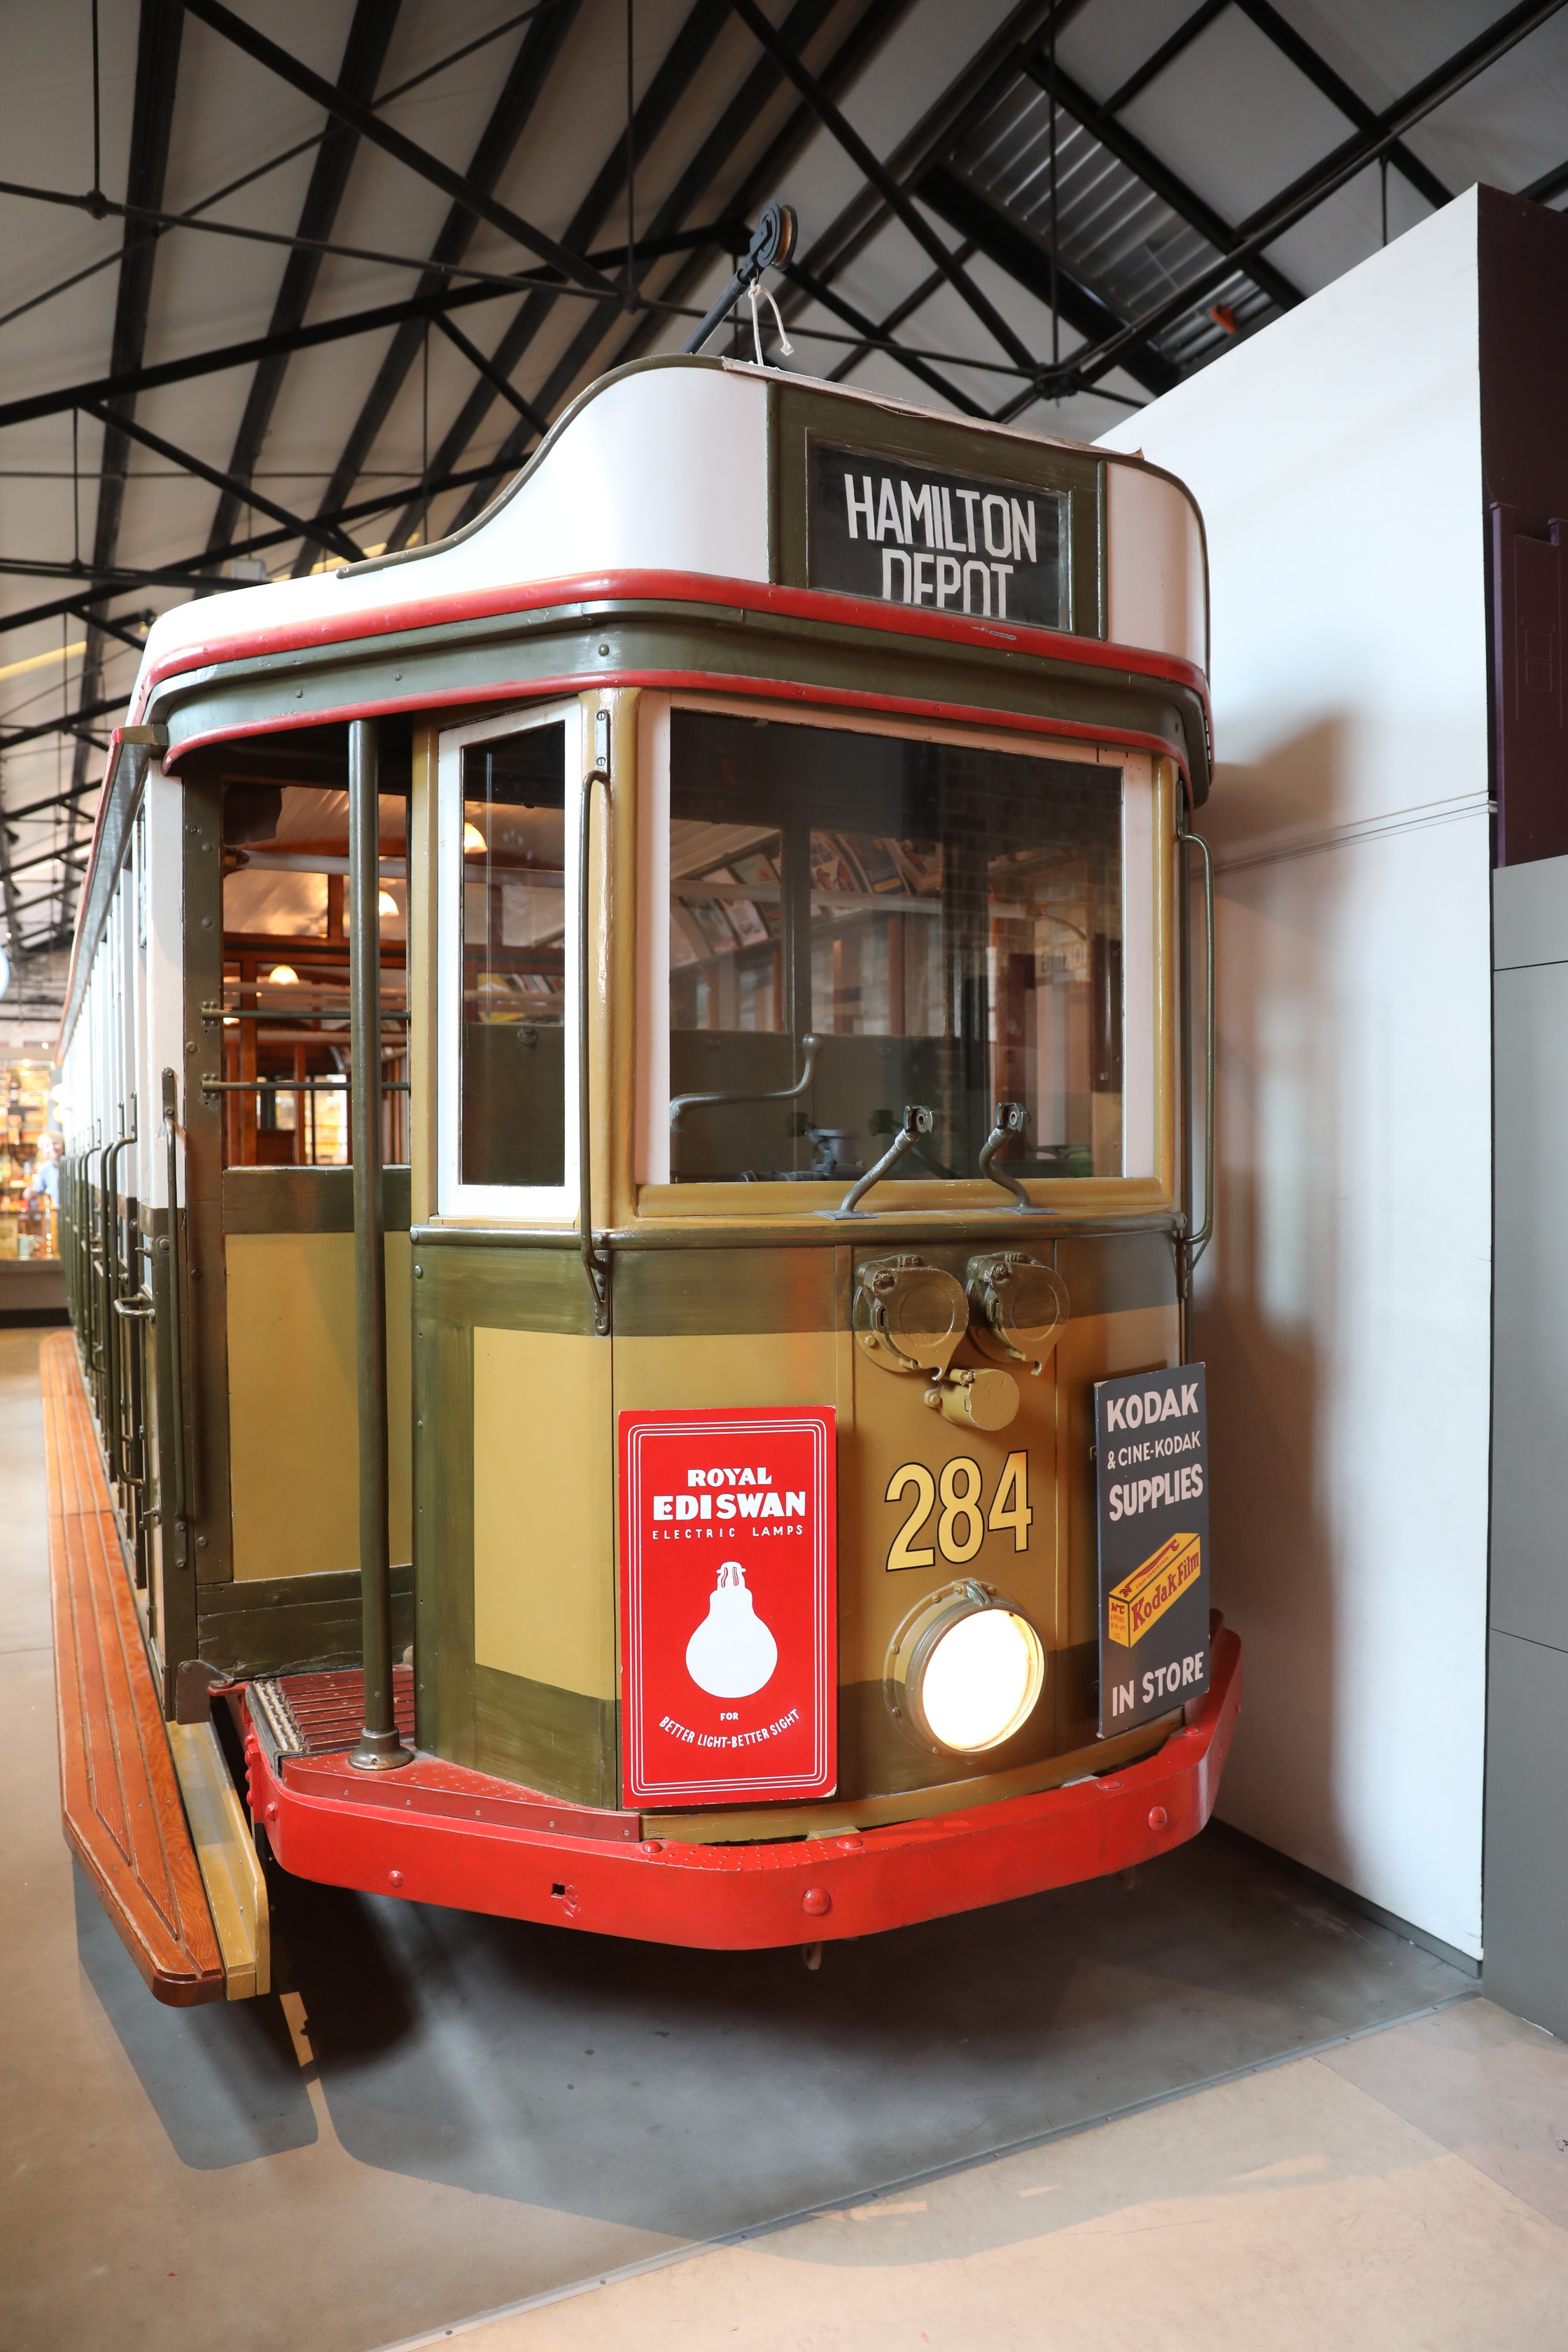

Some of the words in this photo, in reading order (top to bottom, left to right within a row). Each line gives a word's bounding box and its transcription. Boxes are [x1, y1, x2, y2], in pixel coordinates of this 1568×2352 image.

[844, 474, 1037, 563] HAMILTON
[882, 548, 1014, 619] DEPOT
[1107, 1382, 1199, 1432] KODAK
[1107, 1450, 1116, 1470] &
[1118, 1430, 1201, 1466] CINE-KODAK
[687, 1467, 772, 1487] ROYAL
[1109, 1463, 1203, 1521] SUPPLIES
[653, 1491, 806, 1520] EDISWAN
[884, 1449, 1033, 1572] 284
[652, 1527, 735, 1539] ELECTRIC
[752, 1524, 803, 1536] LAMPS
[1131, 1573, 1177, 1632] Kodak
[1177, 1552, 1199, 1587] Film
[1136, 1577, 1147, 1589] FILM
[1112, 1680, 1134, 1717] IN
[1142, 1651, 1204, 1704] STORE
[659, 1716, 695, 1744] BETTER
[770, 1709, 800, 1735] SIGHT
[720, 1712, 738, 1721] FOR
